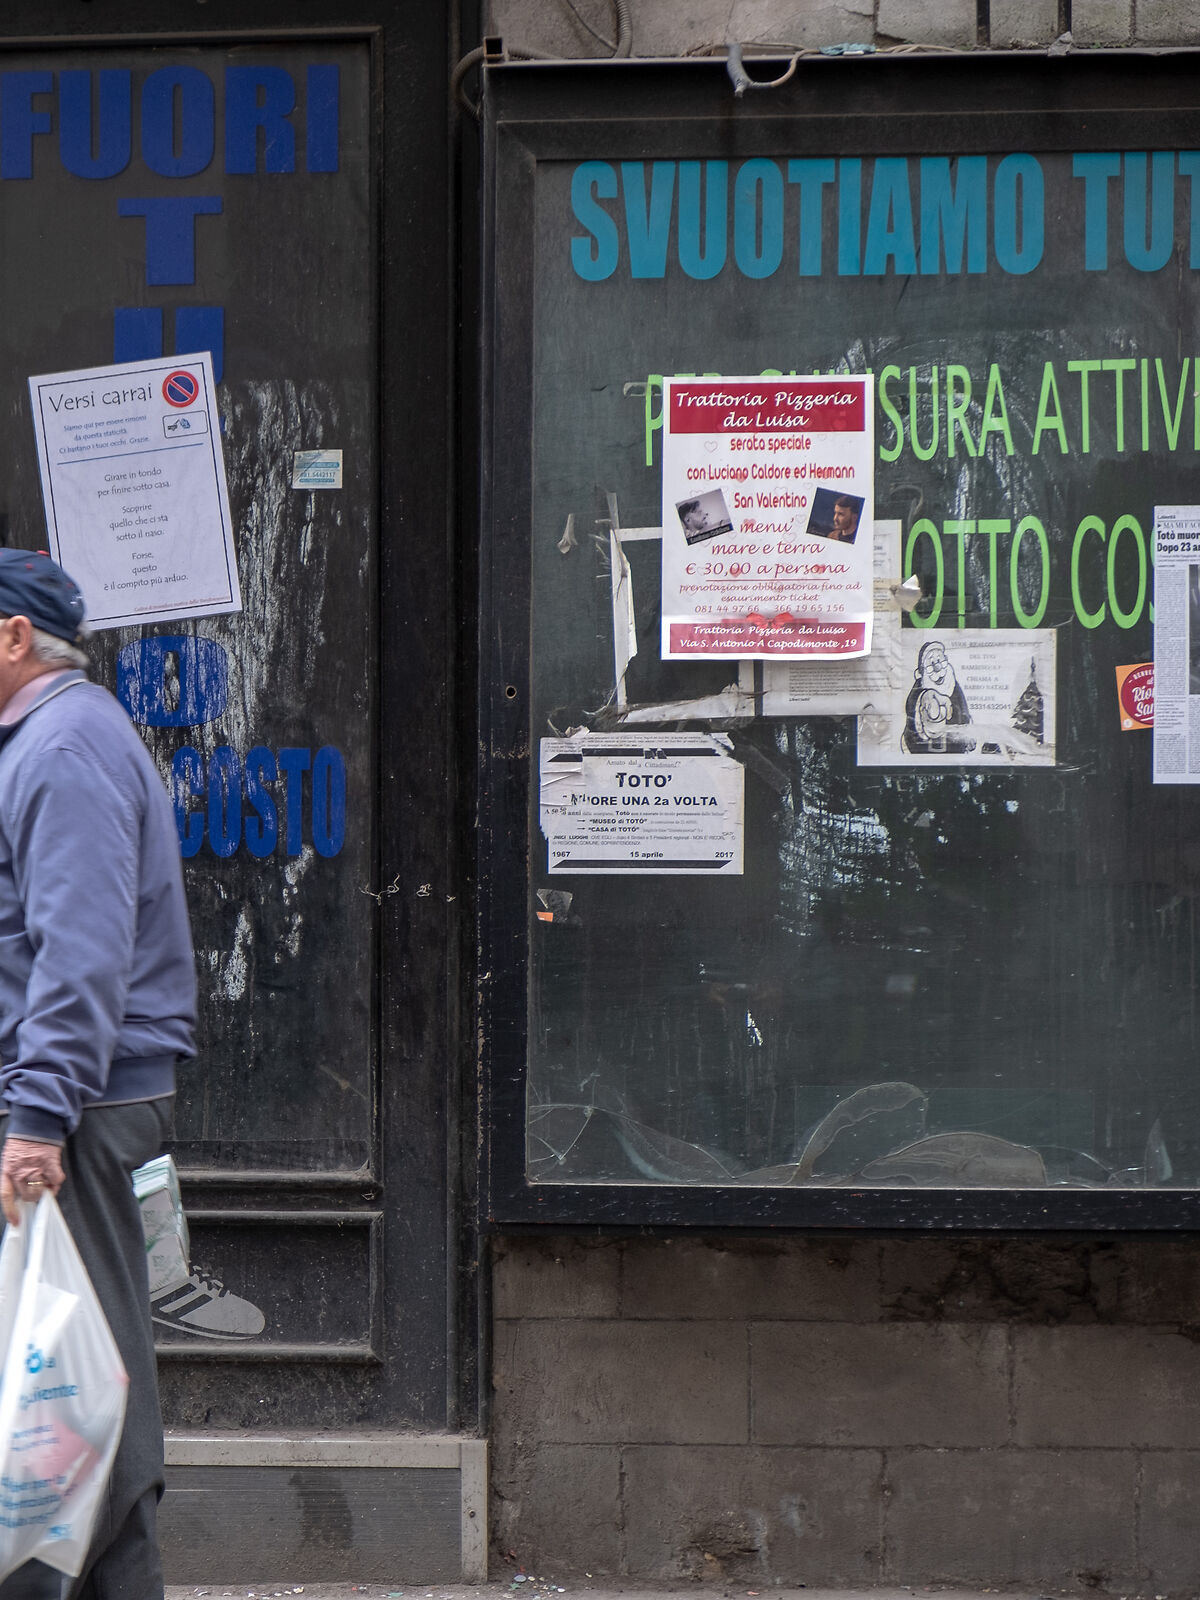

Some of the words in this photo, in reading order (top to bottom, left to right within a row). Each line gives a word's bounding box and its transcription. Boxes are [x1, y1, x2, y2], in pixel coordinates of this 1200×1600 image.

[0, 64, 340, 180] FUORI
[571, 153, 1045, 281] SVUOTIAMO
[49, 391, 95, 412] Versi
[102, 383, 152, 405] carrai
[676, 392, 767, 407] Trattoria
[775, 392, 857, 410] Pizzeria
[723, 412, 753, 427] da
[756, 412, 810, 427] Luisa
[730, 435, 765, 451] serata
[768, 435, 811, 453] speciale
[104, 474, 127, 482] Girare
[138, 467, 162, 477] tondo
[687, 468, 705, 480] con
[709, 464, 748, 480] Luciano
[752, 464, 791, 479] Caldore
[794, 463, 806, 479] ed
[809, 463, 855, 479] Hermann
[97, 488, 110, 497] per
[112, 485, 131, 495] finire
[133, 482, 152, 492] sotto
[734, 493, 753, 508] San
[756, 492, 807, 508] Valentino
[122, 504, 152, 514] Scoprire
[109, 519, 133, 530] quello
[135, 517, 148, 526] che
[740, 518, 794, 534] menu'
[116, 532, 136, 541] sotto
[138, 530, 143, 538] il
[712, 543, 761, 555] mare
[763, 545, 774, 554] e
[777, 541, 825, 554] terra
[686, 563, 696, 575] €
[703, 562, 751, 577] 30,00
[757, 565, 772, 574] a
[774, 563, 850, 578] persona
[904, 515, 1050, 629] OTTO
[1071, 514, 1155, 630] CO
[679, 583, 750, 594] prenotazione
[752, 581, 820, 593] obbligatoria
[821, 583, 843, 592] fino
[845, 582, 862, 590] ad
[721, 594, 789, 603] esaurimento
[789, 593, 820, 601] ticket
[749, 626, 793, 636] Pizzeria
[798, 625, 815, 634] da
[817, 626, 847, 634] Luisa
[680, 639, 700, 648] Via
[700, 639, 709, 648] S.
[712, 639, 756, 648] Antonio
[767, 639, 840, 649] Capodimonte
[171, 745, 346, 858] COSTO
[622, 797, 650, 806] UNA
[654, 796, 669, 806] 2a
[674, 796, 718, 806] VOLTA
[642, 851, 664, 859] aprile
